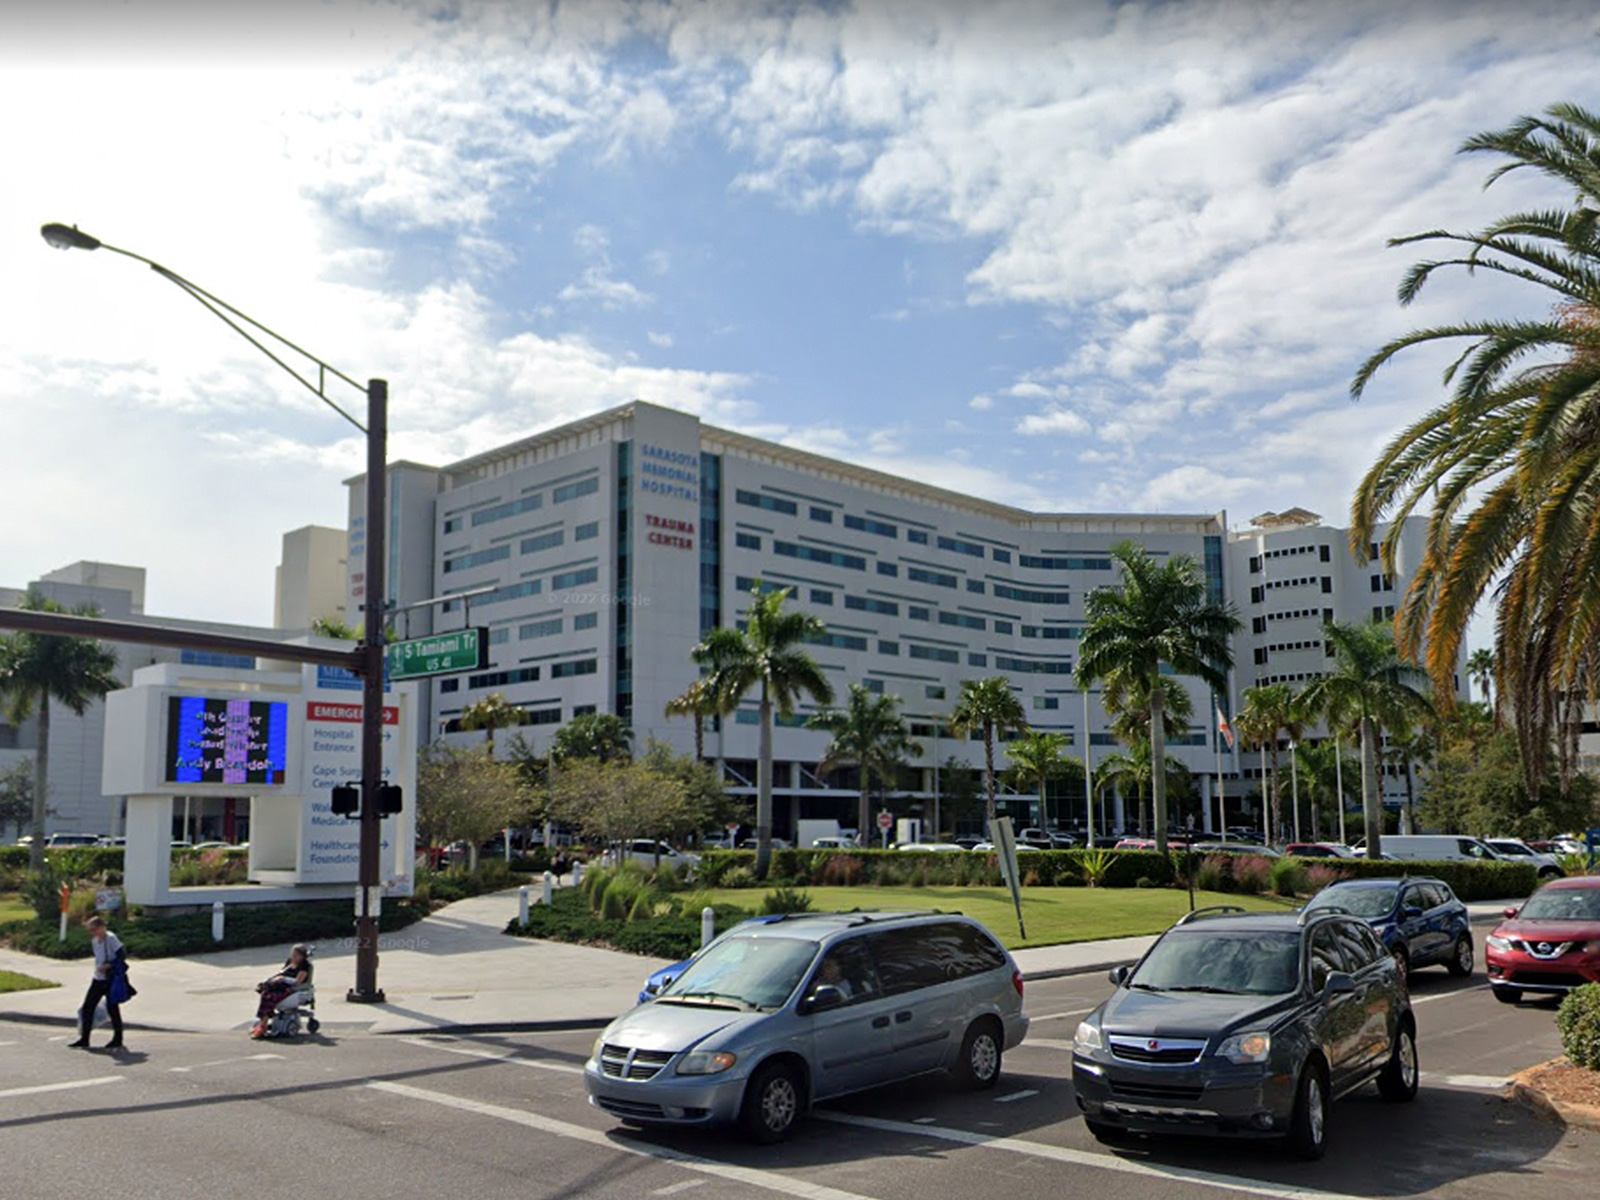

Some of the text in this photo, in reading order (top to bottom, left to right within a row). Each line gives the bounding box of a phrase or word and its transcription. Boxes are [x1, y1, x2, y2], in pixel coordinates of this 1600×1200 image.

[642, 444, 697, 467] SARASOTA
[642, 462, 697, 485] MEMORIAL
[641, 480, 697, 502] HOSPITAL
[645, 514, 694, 534] TRAUMA
[648, 532, 693, 550] CENTER
[405, 634, 475, 658] S Tamiami Tr
[426, 658, 439, 670] US
[314, 706, 363, 719] EMERGE
[313, 728, 354, 740] Hospital
[313, 741, 356, 753] Entrance
[313, 764, 361, 778] Cape Surg
[311, 816, 348, 826] Medical
[310, 840, 360, 850] Healthcar
[310, 854, 359, 864] Foundatio
